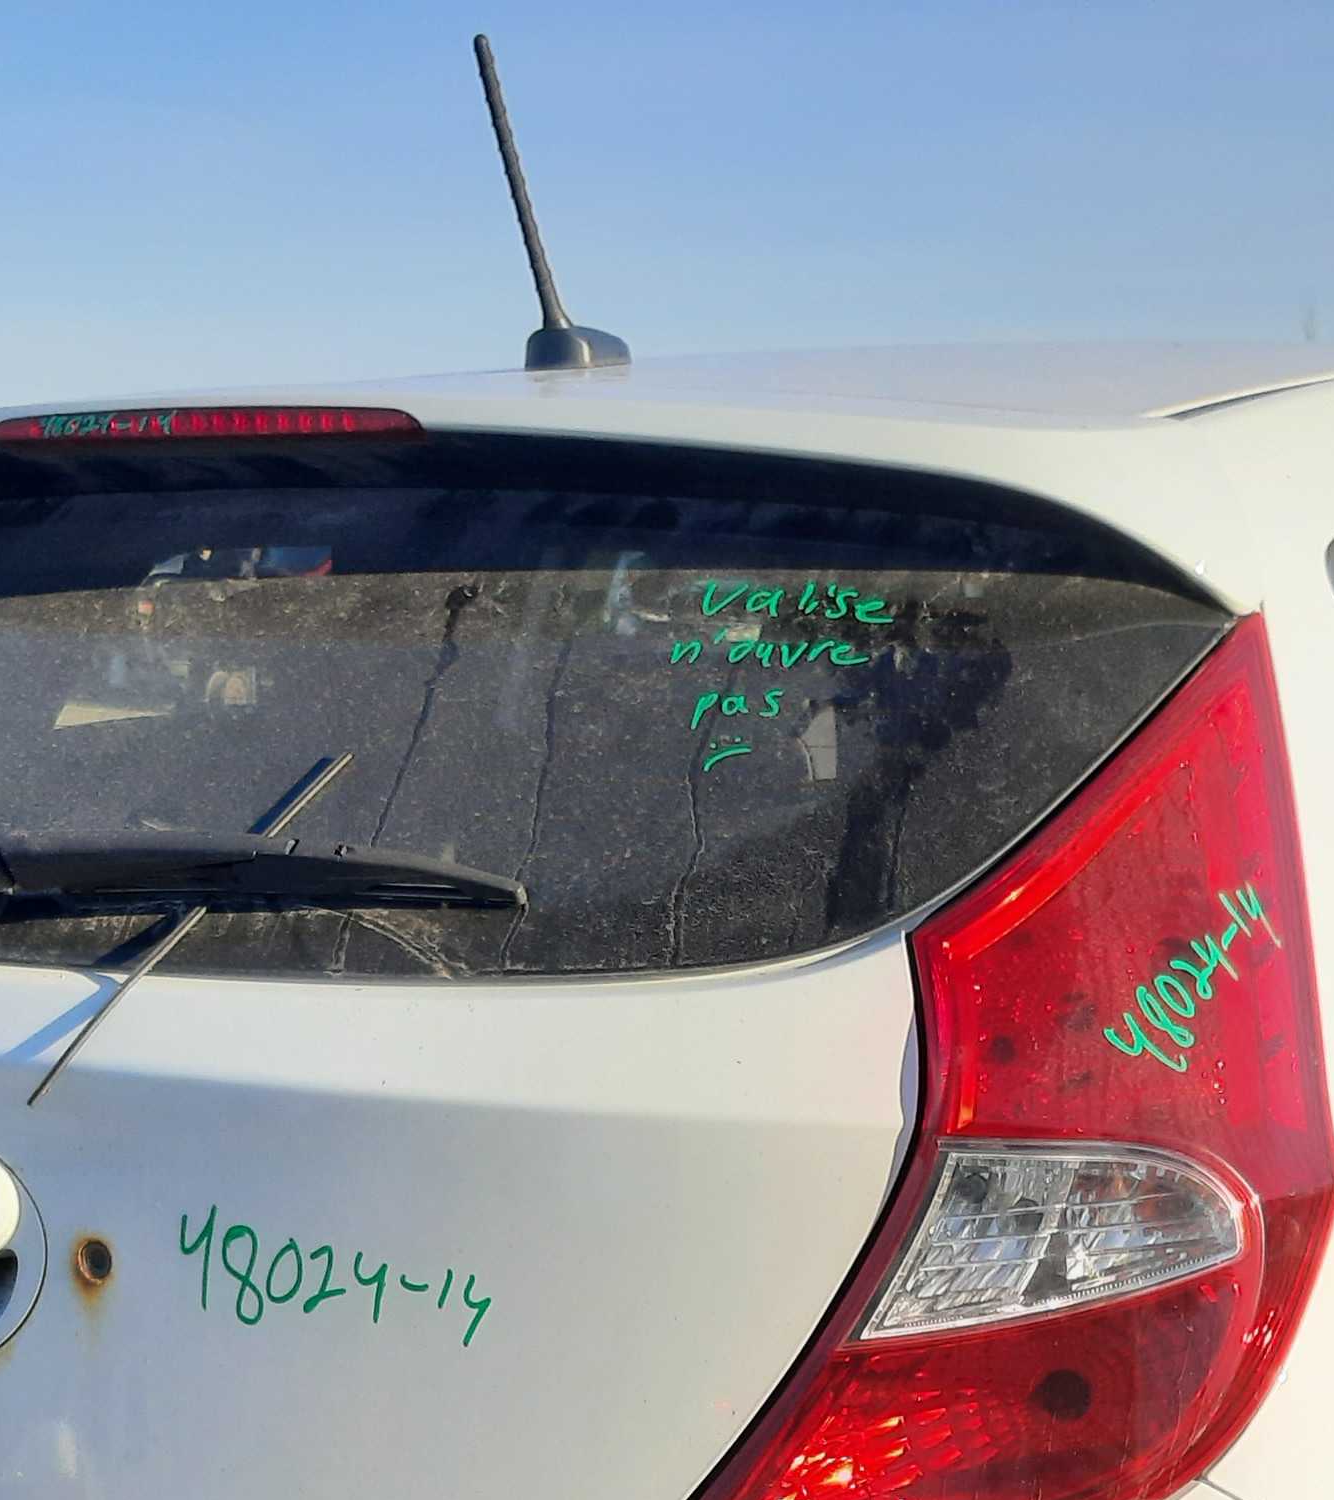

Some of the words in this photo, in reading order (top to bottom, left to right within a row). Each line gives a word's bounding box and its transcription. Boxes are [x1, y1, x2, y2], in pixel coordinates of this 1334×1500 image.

[670, 627, 871, 670] n'ouvre
[689, 688, 784, 731] pas
[1102, 879, 1284, 1074] 48024-14
[179, 1203, 493, 1348] 48024-14
